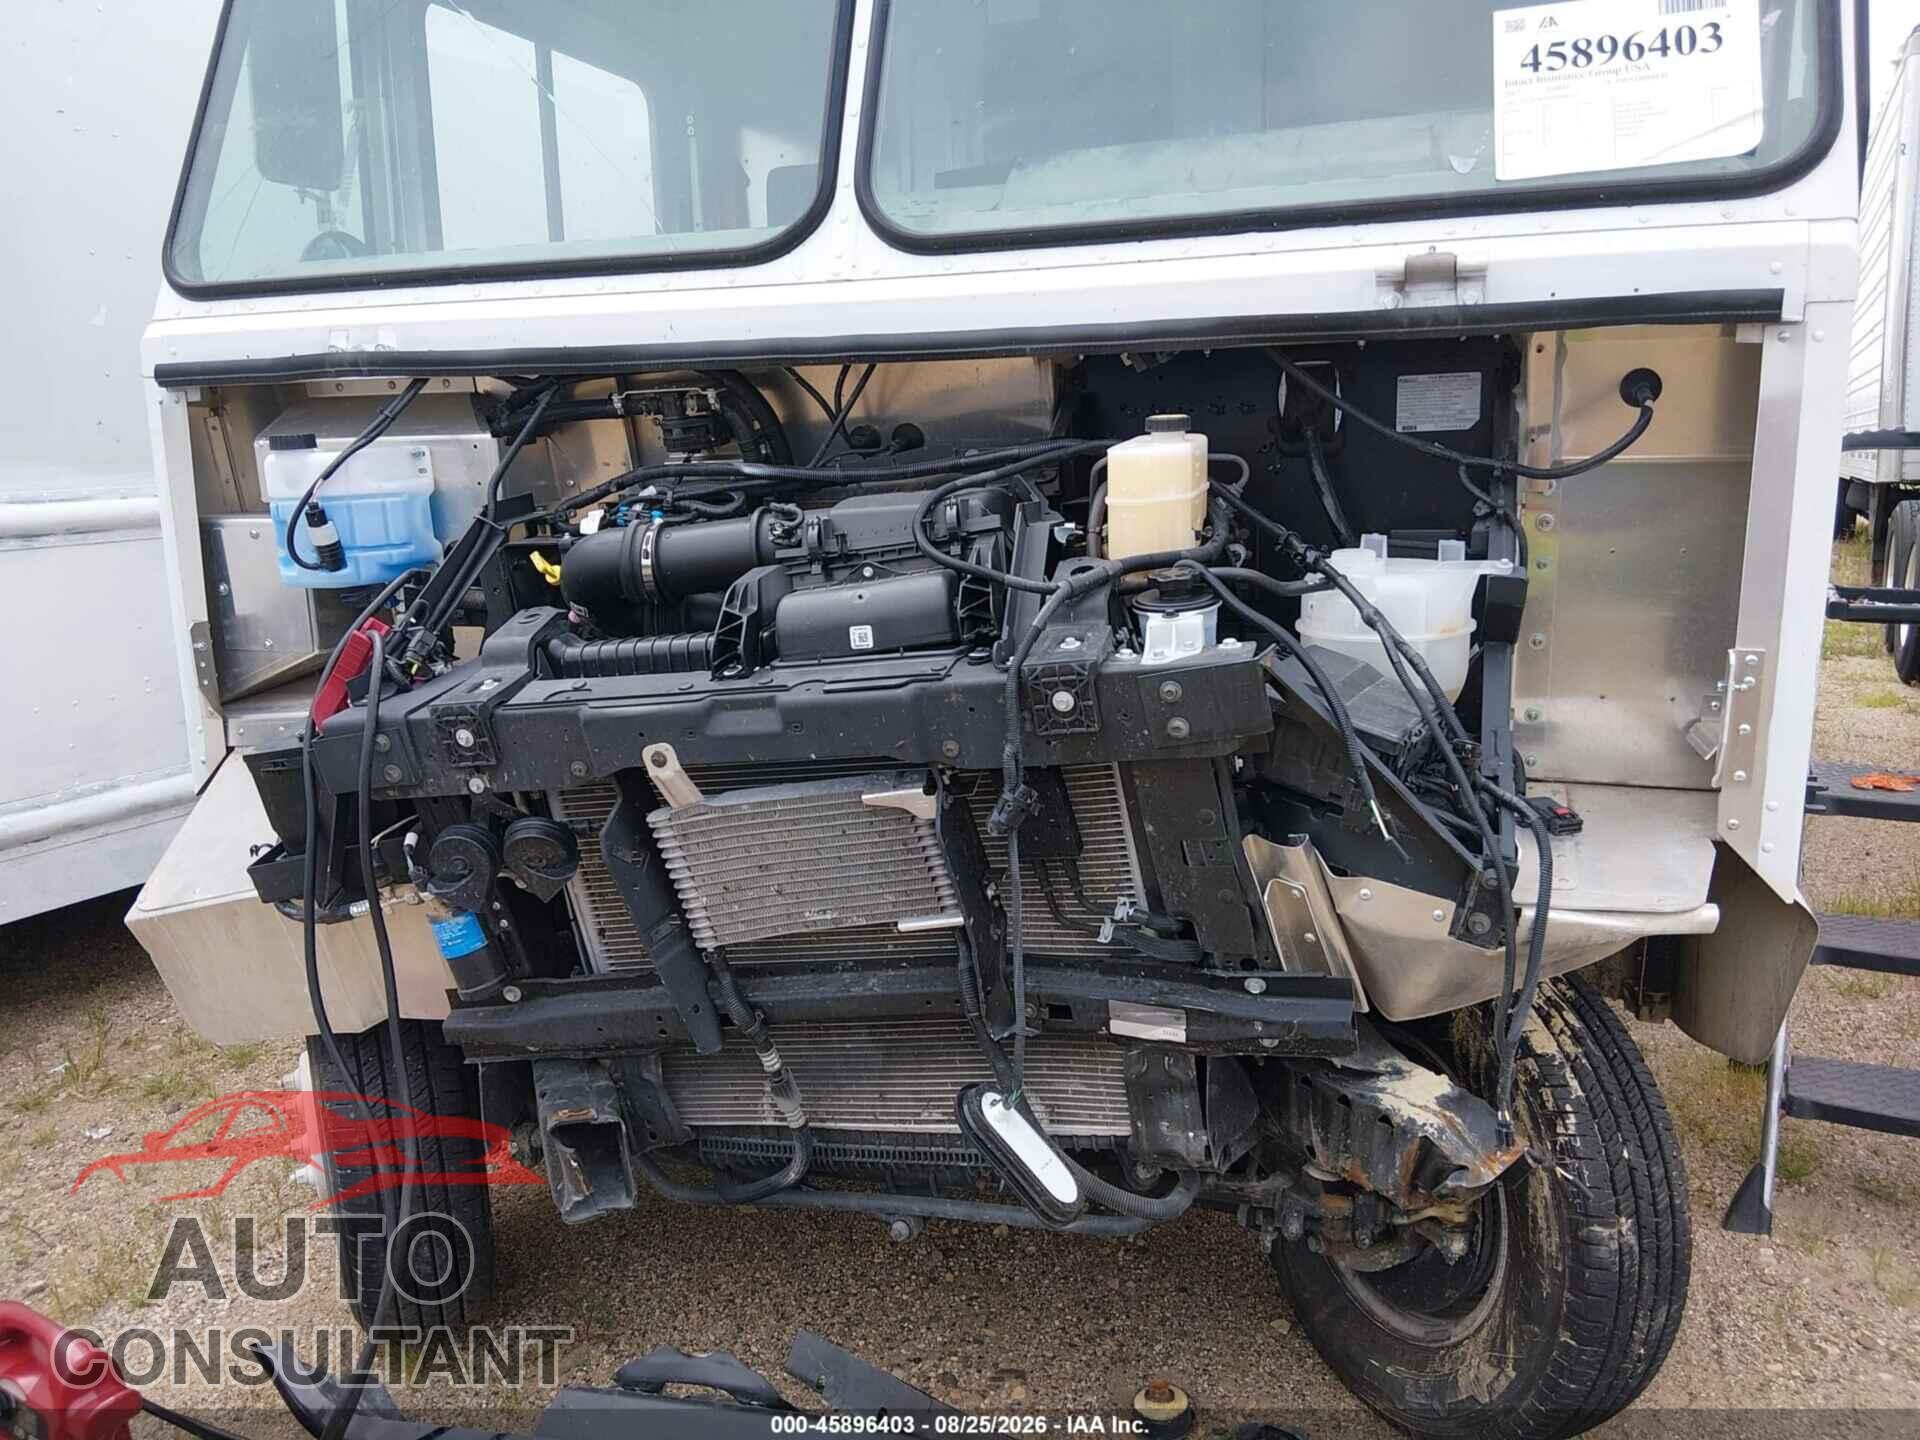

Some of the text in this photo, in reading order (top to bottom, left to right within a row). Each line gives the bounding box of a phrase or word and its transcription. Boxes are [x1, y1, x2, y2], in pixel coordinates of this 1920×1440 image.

[1520, 21, 1723, 72] 45896403
[1588, 67, 1622, 80] Group
[1626, 63, 1652, 74] USA
